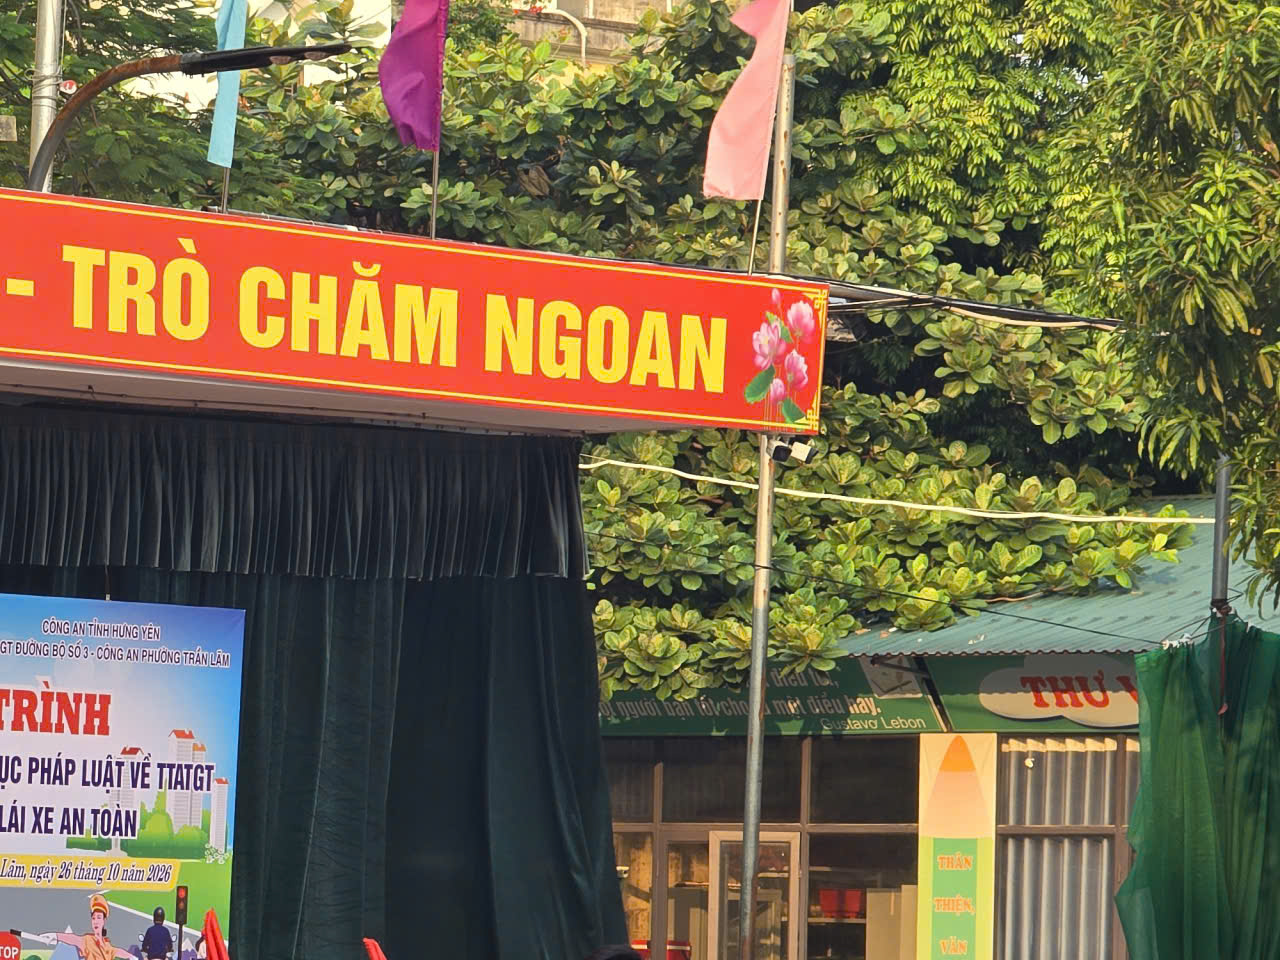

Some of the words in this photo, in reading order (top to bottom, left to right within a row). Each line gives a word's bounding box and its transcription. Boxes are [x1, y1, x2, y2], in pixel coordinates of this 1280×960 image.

[6, 278, 35, 297] -
[63, 238, 210, 343] TRÒ
[239, 261, 459, 368] CHĂM
[485, 297, 728, 394] NGOAN
[42, 617, 70, 635] CÔNG
[72, 622, 87, 637] AN
[111, 623, 139, 640] HƯNG
[141, 622, 161, 641] YÊN
[52, 642, 66, 662] BỘ
[67, 640, 82, 659] SỐ
[83, 646, 89, 660] 3
[96, 643, 125, 661] CÔNG
[126, 648, 139, 662] AN
[1020, 669, 1110, 708] THƯ
[882, 716, 927, 730] Lebon
[27, 752, 76, 786] PHÁP
[81, 754, 125, 794] LUẬT
[130, 752, 152, 789] VỀ
[156, 762, 215, 792] TTATGT
[31, 806, 55, 835] XE
[59, 807, 85, 836] AN
[90, 803, 137, 837] TOÀN
[29, 861, 57, 883] ngày
[58, 862, 73, 879] 26
[73, 861, 106, 885] tháng
[107, 862, 120, 880] 10
[121, 865, 145, 882] năm
[148, 864, 173, 883] 2026
[939, 936, 968, 955] VĂN
